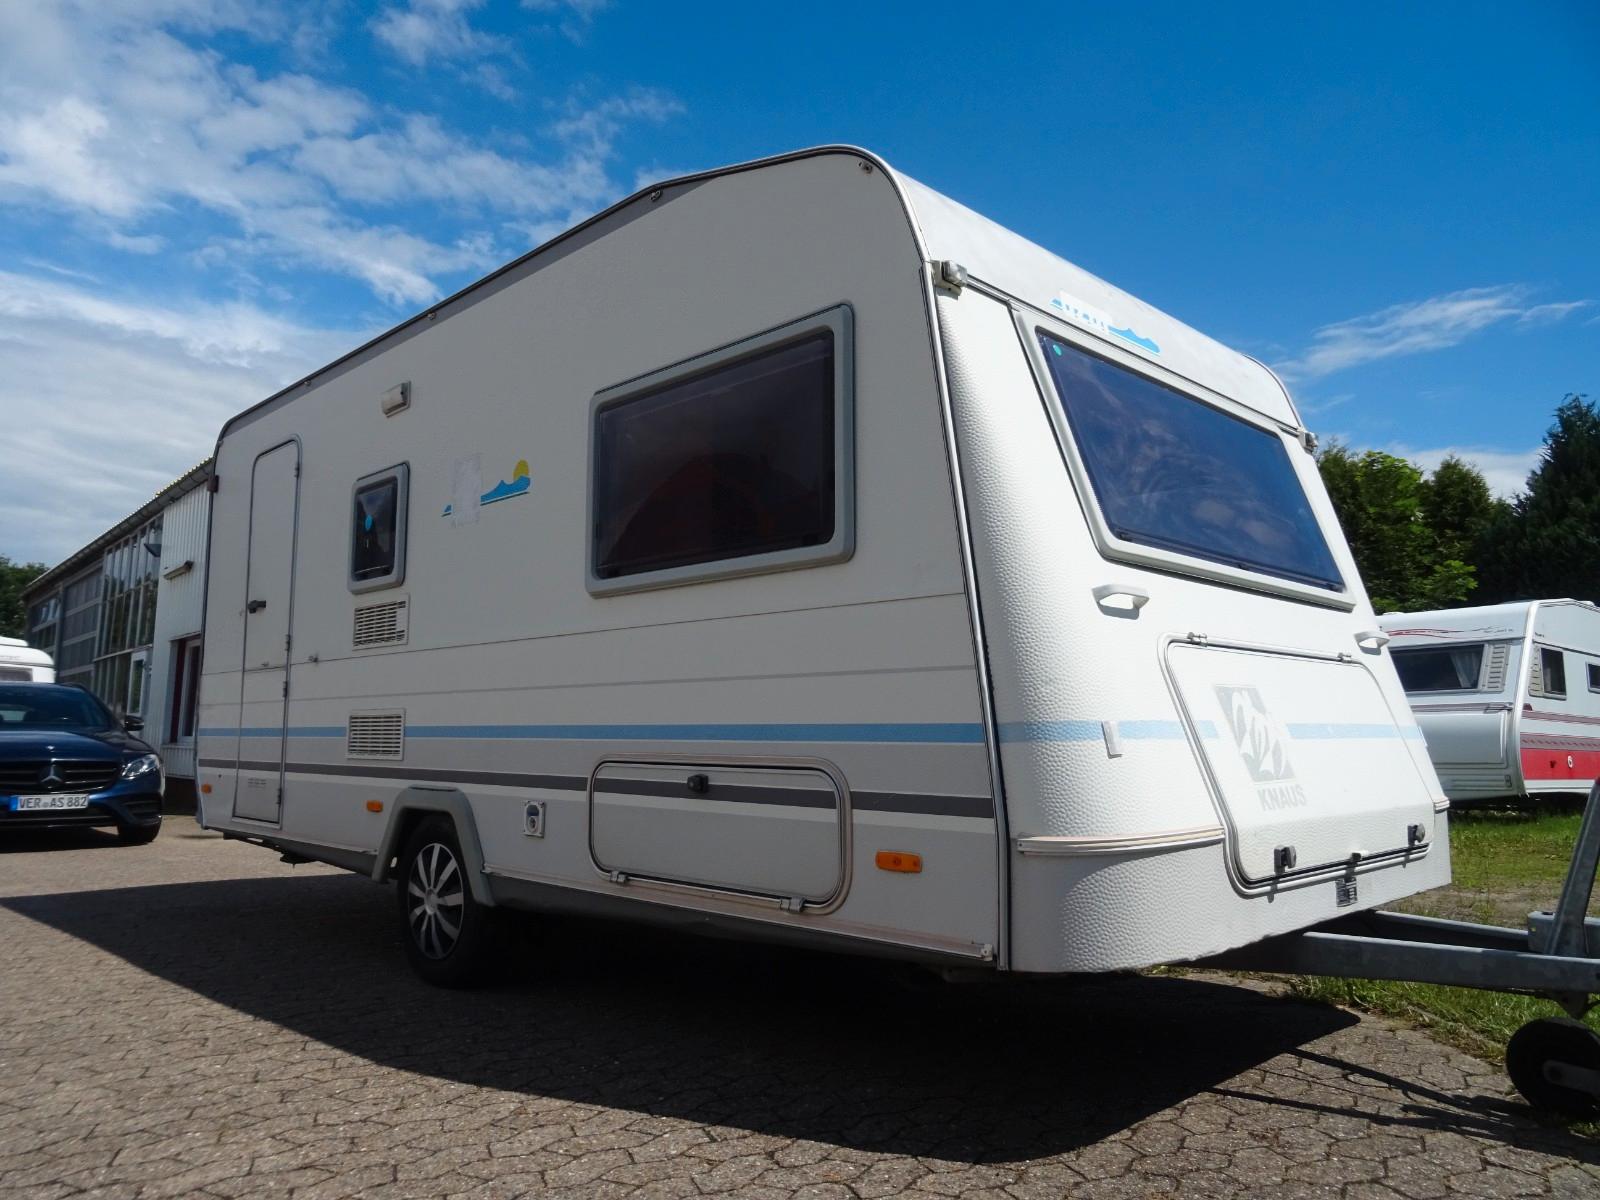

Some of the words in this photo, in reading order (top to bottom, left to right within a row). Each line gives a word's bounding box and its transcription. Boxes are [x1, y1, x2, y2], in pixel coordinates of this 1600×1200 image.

[19, 797, 41, 809] VER
[50, 797, 65, 808] AS
[66, 796, 87, 808] 882
[1258, 784, 1307, 811] KNAUS
